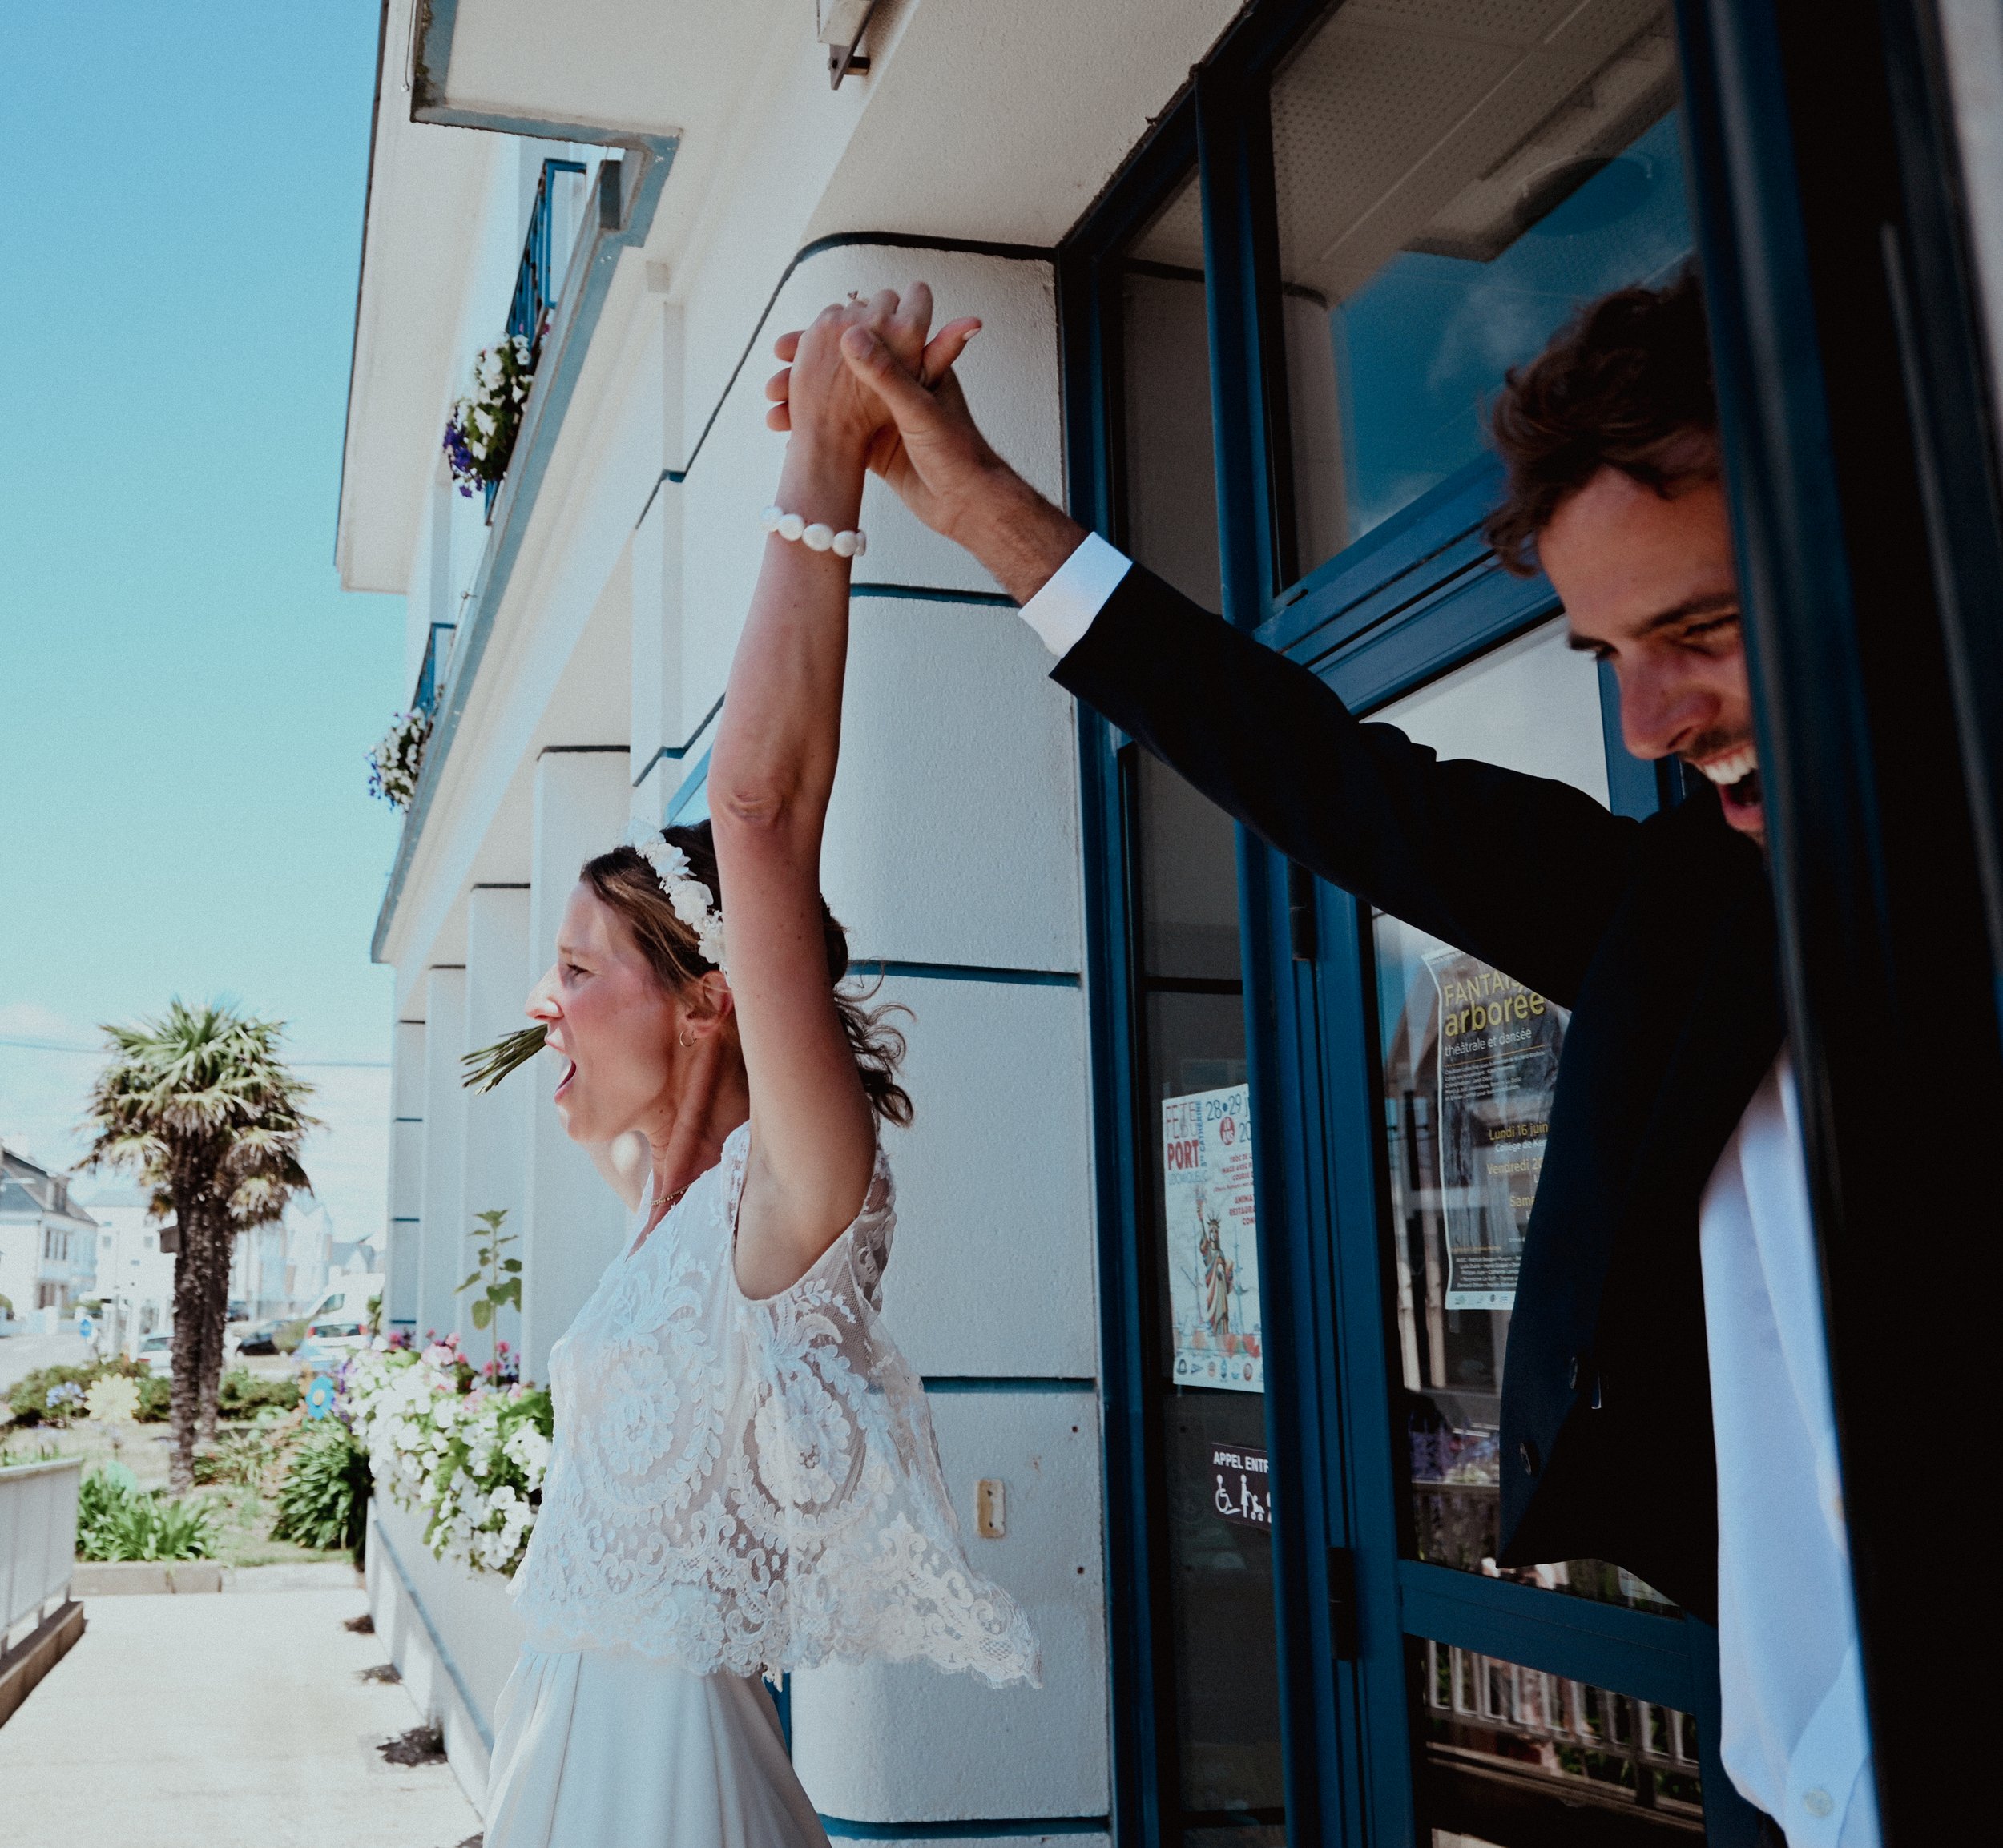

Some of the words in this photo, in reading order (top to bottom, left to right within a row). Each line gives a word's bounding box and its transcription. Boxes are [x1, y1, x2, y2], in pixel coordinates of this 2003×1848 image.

[1445, 992, 1546, 1037] arborée
[1445, 1037, 1486, 1057] théâtrale
[1487, 1037, 1497, 1047] et
[1499, 1027, 1532, 1045] dansée
[1239, 1121, 1251, 1142] 20
[1489, 1125, 1515, 1141] Lundi
[1517, 1124, 1528, 1136] 16
[1529, 1121, 1549, 1137] juin
[1522, 1140, 1532, 1149] de
[1533, 1138, 1547, 1148] Ker
[1167, 1139, 1199, 1170] PORT
[1486, 1158, 1529, 1174] Vendredi
[1235, 1194, 1253, 1203] ANIMA
[1213, 1451, 1243, 1470] APPEL
[1245, 1456, 1269, 1474] ENTR
